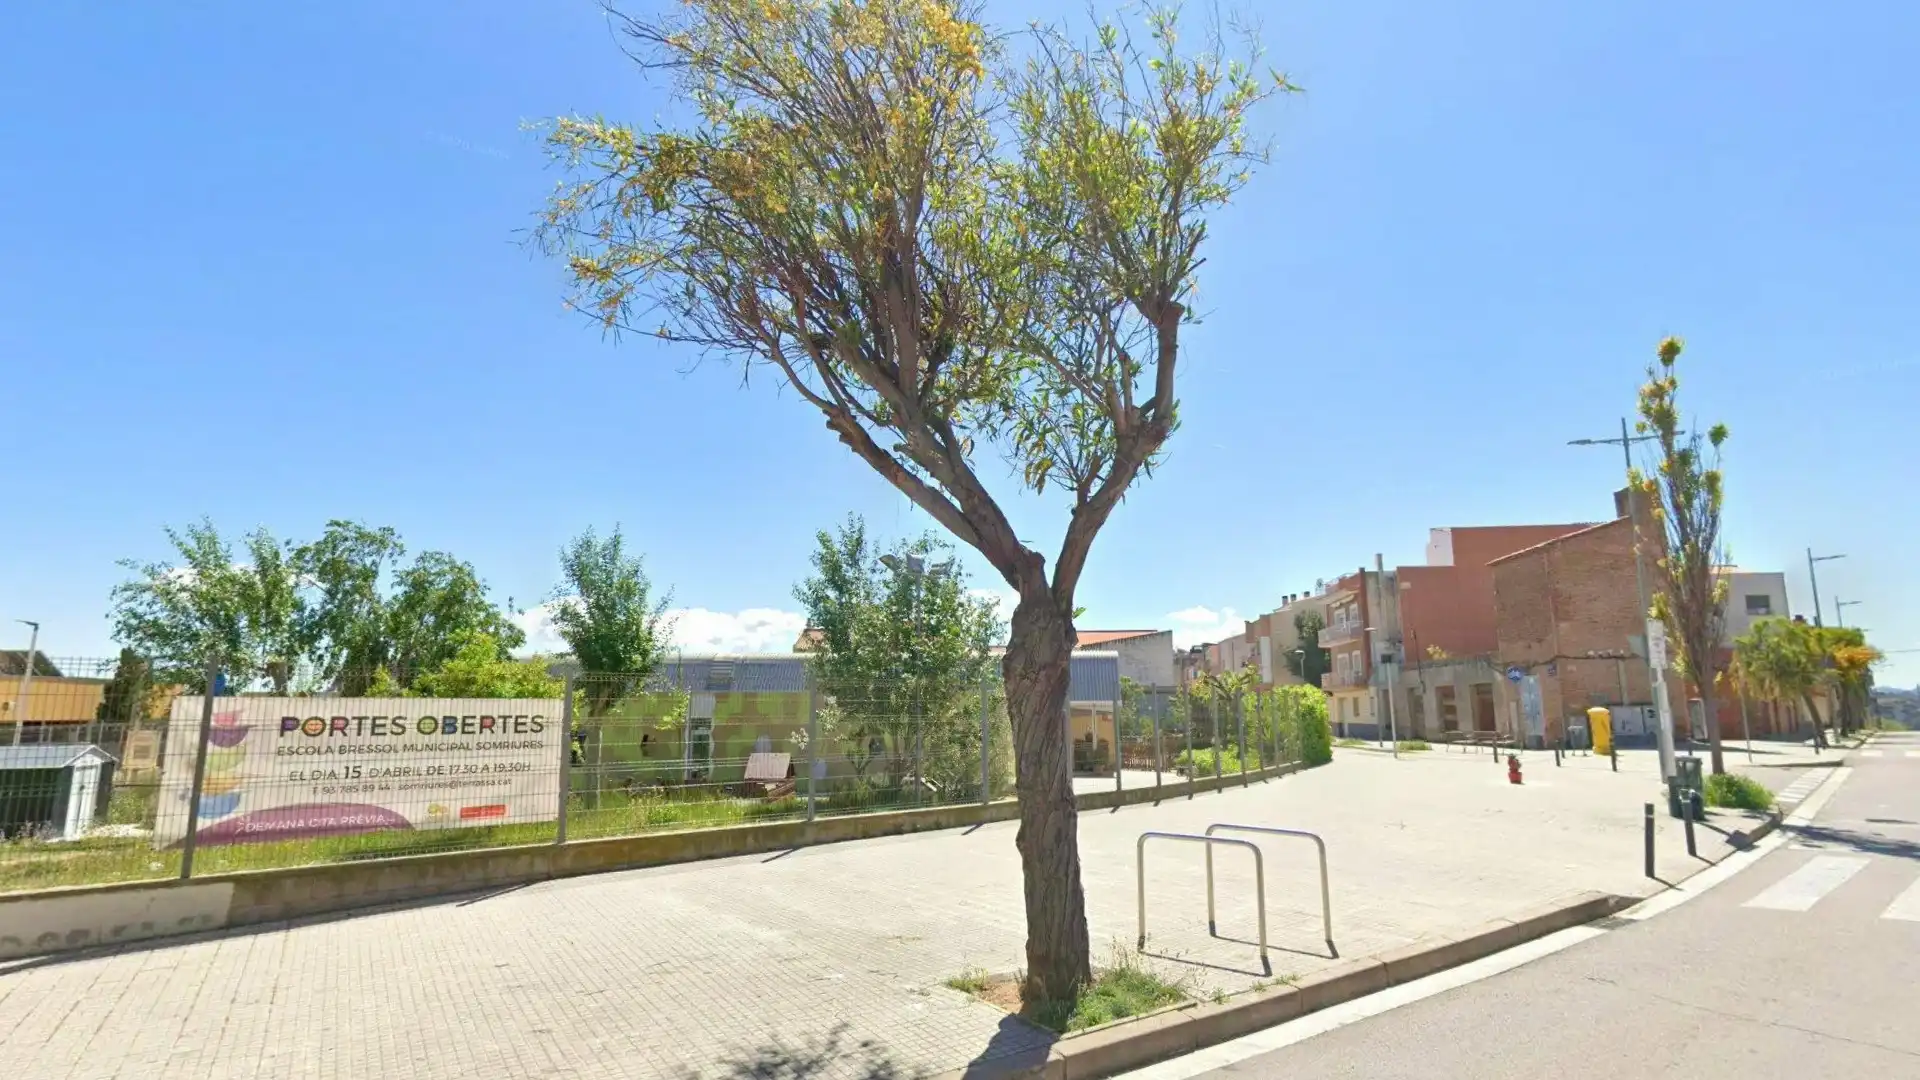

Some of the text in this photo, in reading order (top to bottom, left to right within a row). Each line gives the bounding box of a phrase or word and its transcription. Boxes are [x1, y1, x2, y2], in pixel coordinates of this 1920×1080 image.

[279, 714, 545, 737] PORTES OBERTES
[277, 740, 543, 756] ESCOLA BRESSOL MUNICIPAL SOMRIURES
[289, 770, 306, 781] EL
[311, 768, 338, 780] DIA
[344, 765, 362, 779] 15
[426, 765, 445, 776] DE
[480, 764, 490, 774] A
[245, 819, 305, 833] DEMANA
